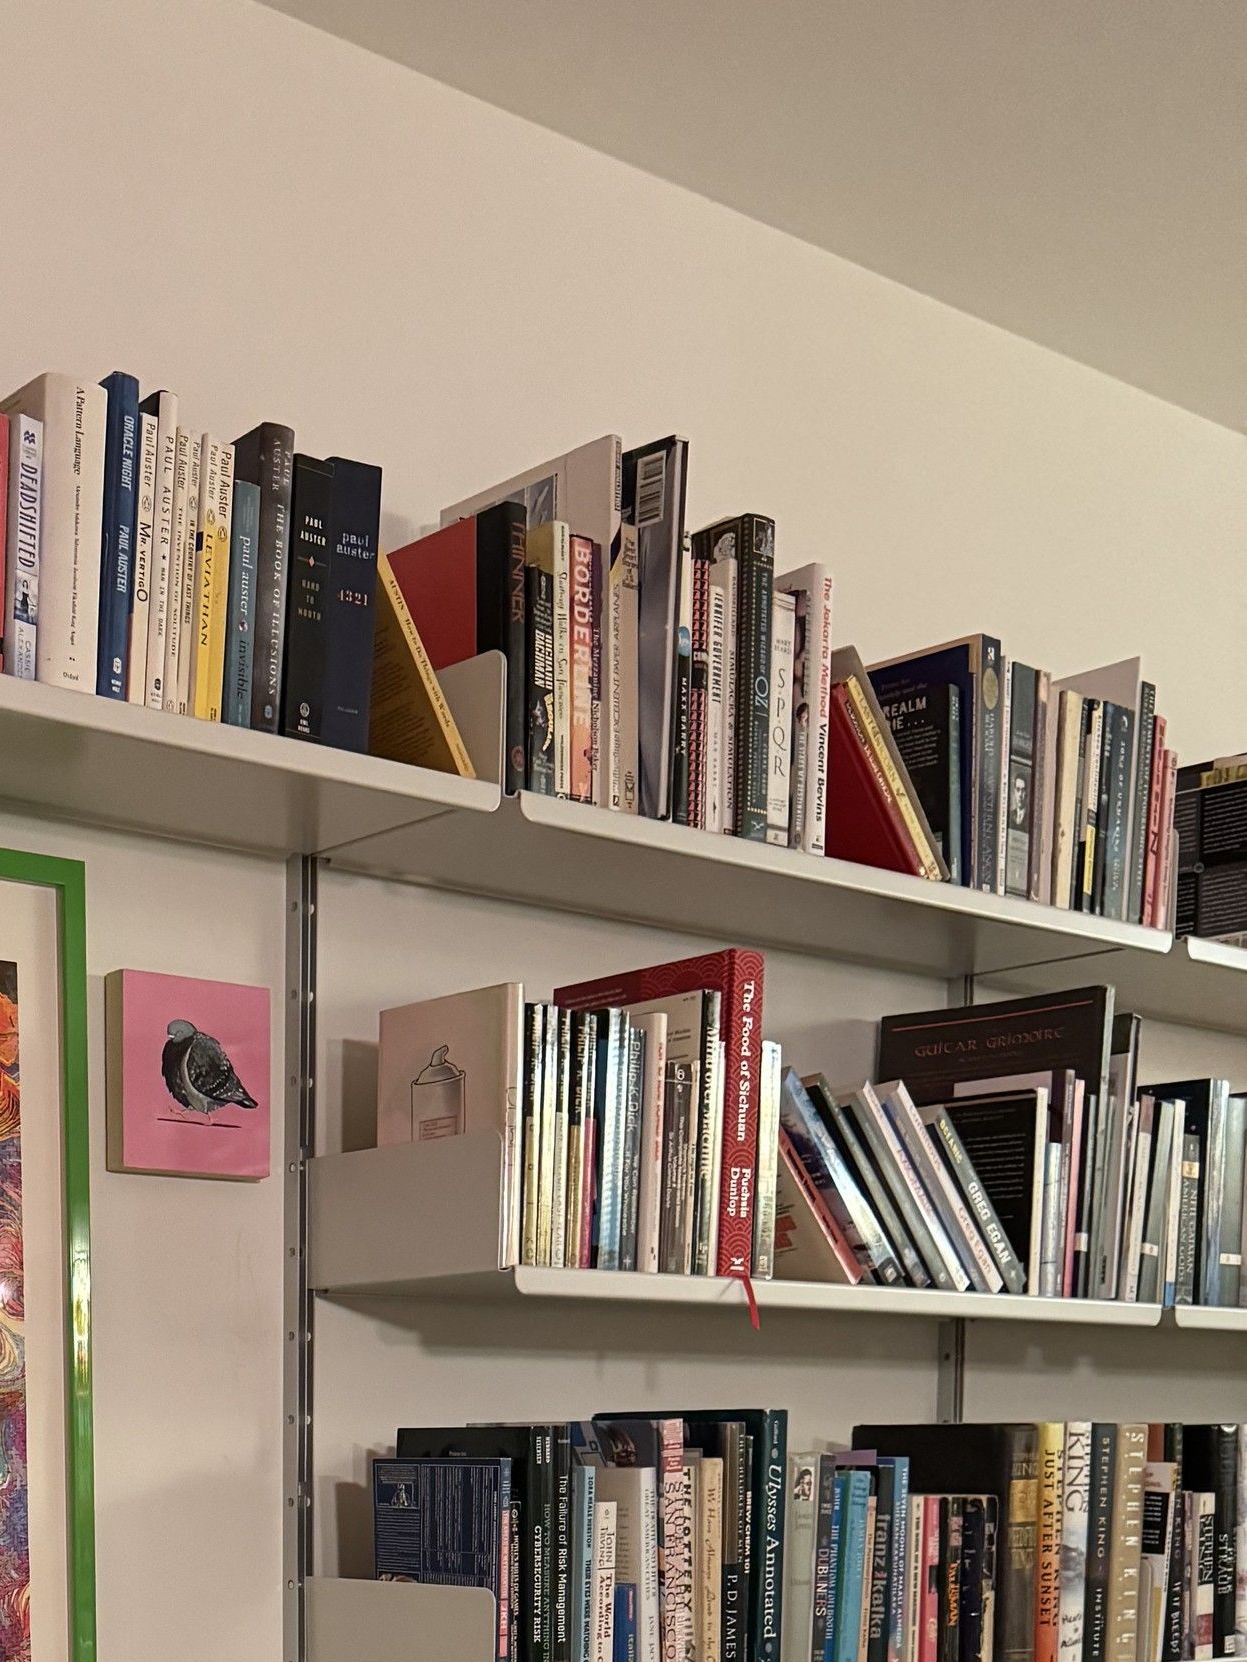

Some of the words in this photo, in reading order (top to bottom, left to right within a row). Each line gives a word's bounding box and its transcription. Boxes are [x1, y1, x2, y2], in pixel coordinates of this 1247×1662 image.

[122, 415, 135, 457] ORACLE
[146, 422, 157, 448] Paul
[163, 436, 175, 474] PAUL
[120, 459, 133, 492] NIGHT
[144, 450, 156, 489] Auster
[221, 451, 232, 480] Paul
[17, 461, 38, 574] DEADSHIFTED
[160, 485, 173, 545] AUSTER
[218, 480, 231, 519] Auster
[276, 503, 285, 533] THE
[117, 524, 131, 551] PAUL
[299, 530, 327, 547] AUSTER
[304, 515, 324, 530] PAUL
[341, 531, 370, 547] paul
[116, 553, 128, 594] AUSTER
[240, 536, 252, 566] paul
[273, 538, 283, 583] BOOK
[336, 543, 375, 560] auster
[200, 533, 213, 646] LEVIATHAN
[239, 570, 249, 617] auster
[271, 589, 281, 606] OF
[823, 577, 832, 602] The
[714, 592, 724, 638] JENNIFER
[819, 604, 831, 660] Jakarta
[236, 639, 250, 700] invisible
[268, 611, 280, 697] ILLUSIONS
[534, 629, 546, 689] BACHMAN
[711, 640, 723, 704] GOVERNMENT
[818, 664, 830, 719] Method
[817, 723, 828, 776] Vincent
[815, 778, 825, 823] Bevins
[742, 980, 755, 1013] The
[739, 1016, 753, 1058] Food
[739, 1060, 751, 1078] of
[736, 1077, 751, 1142] Sichuan
[727, 1166, 740, 1218] Dunlop
[738, 1167, 751, 1219] Fuchsia
[938, 1119, 964, 1164] OCEANIC
[967, 1181, 991, 1225] GREG
[988, 1222, 1011, 1264] EGAN
[558, 1474, 569, 1494] The
[1044, 1449, 1055, 1490] JUST
[1065, 1430, 1086, 1514] KING
[1099, 1437, 1110, 1508] STEPHEN
[558, 1496, 569, 1532] Failure
[765, 1464, 782, 1532] Ulysses
[558, 1535, 568, 1546] of
[1041, 1499, 1054, 1555] AFTER
[1096, 1516, 1107, 1558] KING
[533, 1525, 542, 1615] CYBERSECURITY
[558, 1548, 568, 1571] Risk
[763, 1536, 780, 1639] Annotated
[815, 1548, 830, 1618] DUBLINERS
[1038, 1561, 1052, 1628] SUNSET
[533, 1617, 542, 1643] RISK
[555, 1573, 567, 1643] Management
[725, 1609, 738, 1659] JAMES
